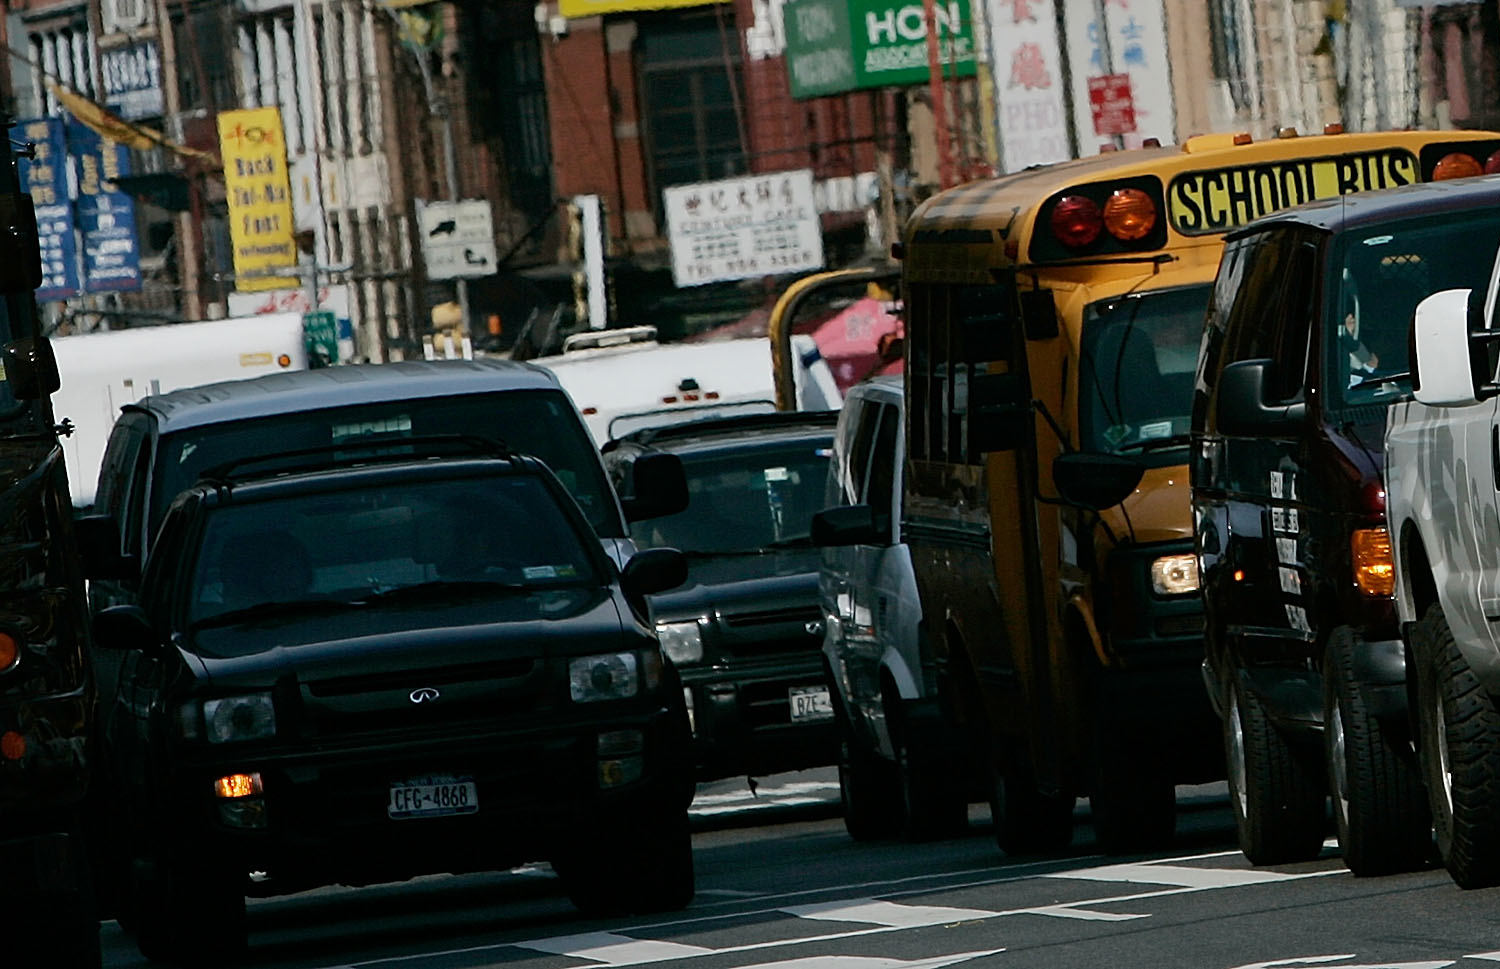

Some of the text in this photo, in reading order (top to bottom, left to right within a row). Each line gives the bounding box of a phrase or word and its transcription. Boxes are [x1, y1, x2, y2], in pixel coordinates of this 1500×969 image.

[865, 0, 961, 45] HON
[1174, 153, 1411, 231] SCHOOL BUS
